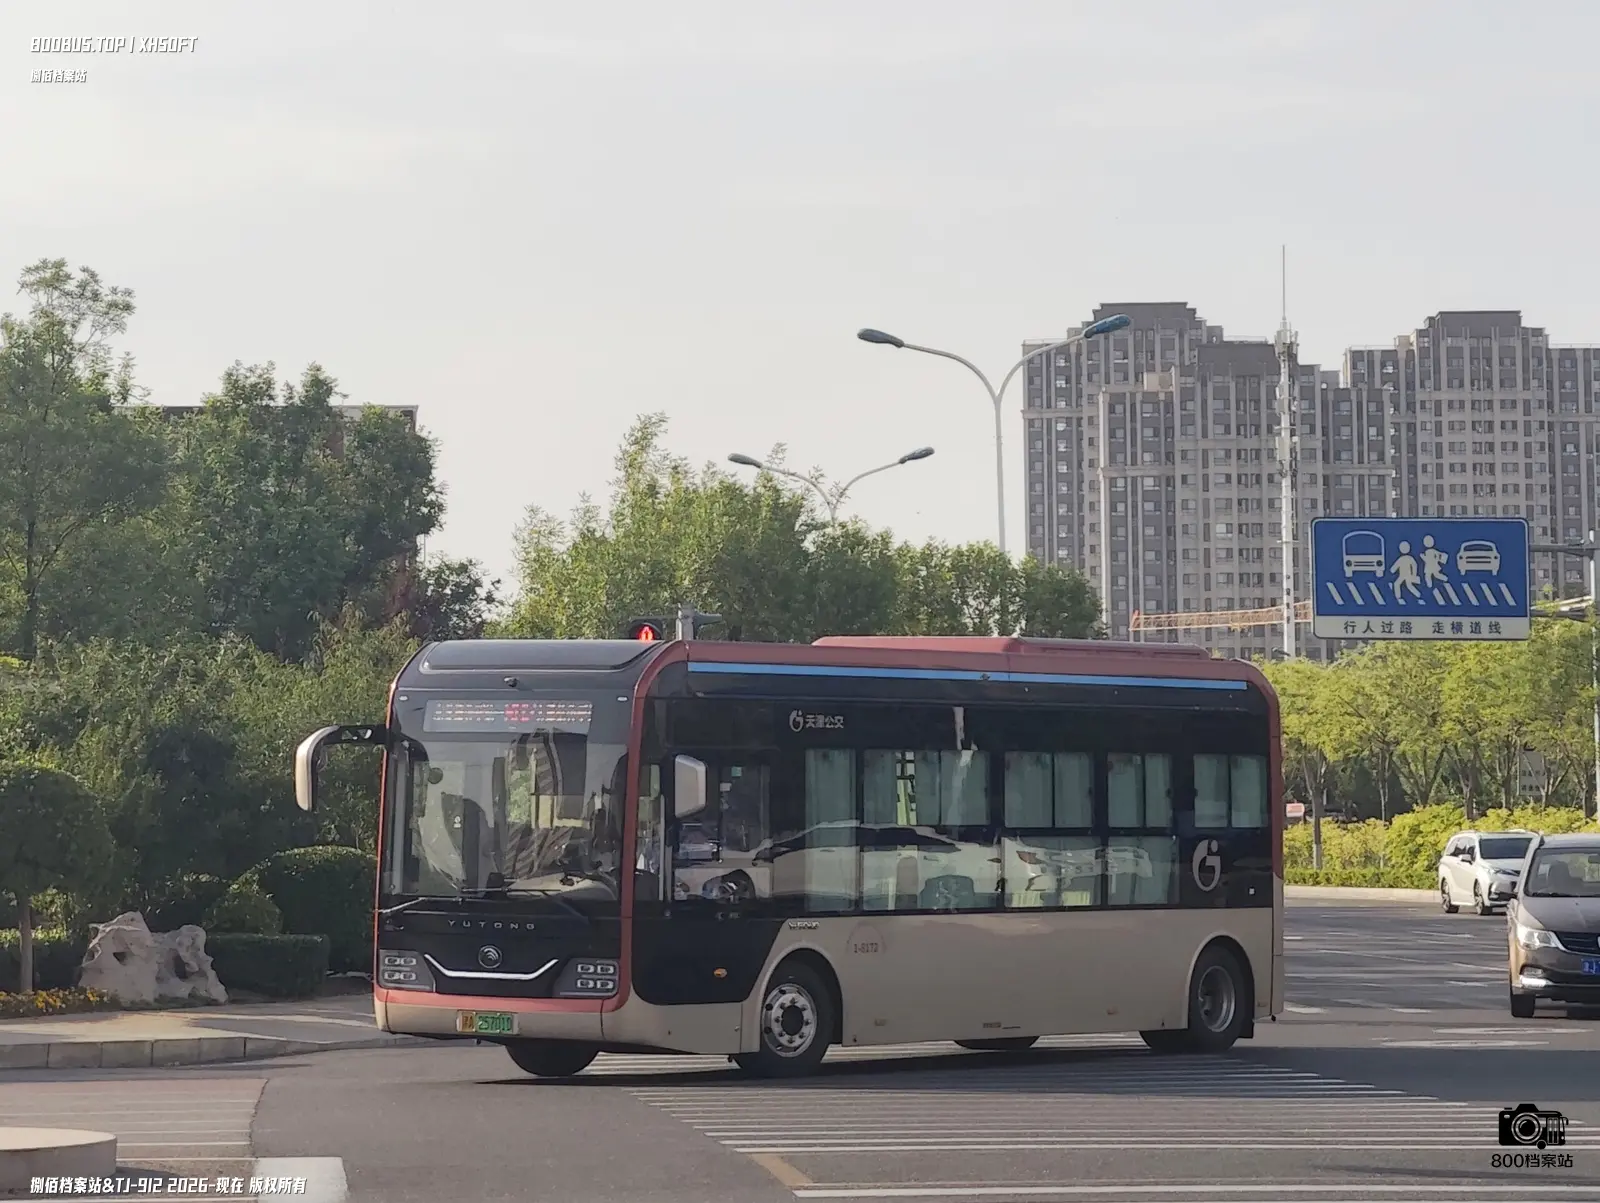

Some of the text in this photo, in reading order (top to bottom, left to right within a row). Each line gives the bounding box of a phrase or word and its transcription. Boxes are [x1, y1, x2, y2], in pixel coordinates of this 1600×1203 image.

[1344, 620, 1502, 635] 行人过路 走横道线
[448, 920, 535, 930] YUTONG
